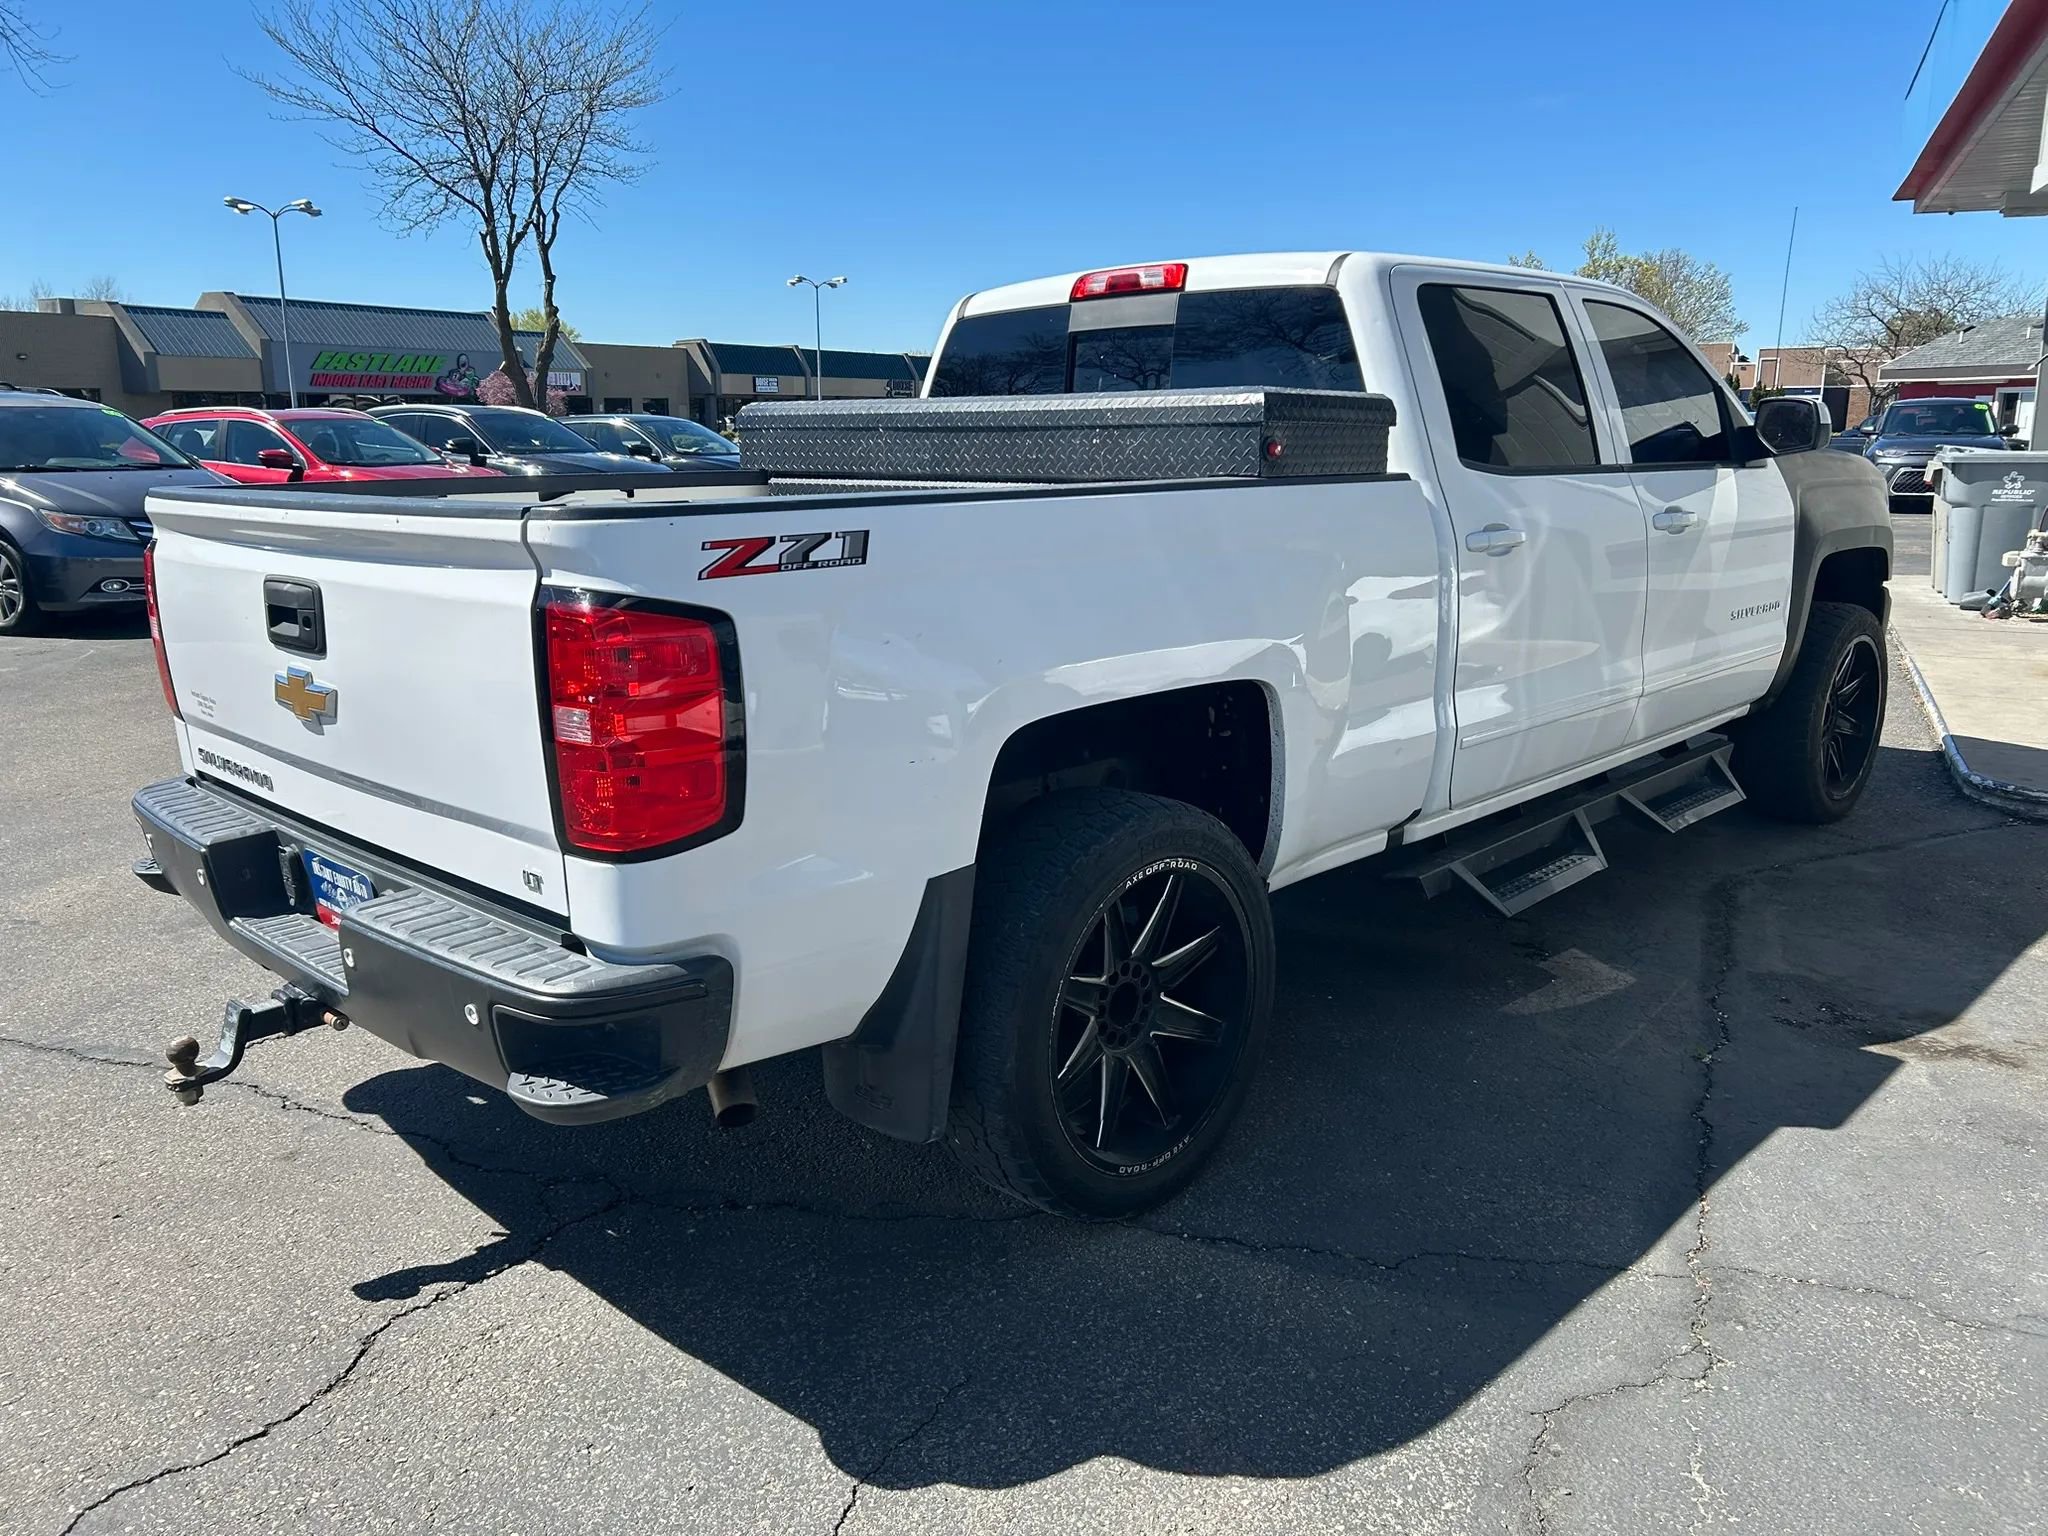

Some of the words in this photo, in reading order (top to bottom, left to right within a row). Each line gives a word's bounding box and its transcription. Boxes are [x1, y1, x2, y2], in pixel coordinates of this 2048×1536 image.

[311, 351, 447, 373] FASTLANE
[310, 373, 358, 387] INDOOR
[359, 374, 387, 388] KART
[390, 375, 434, 389] RACING
[698, 530, 870, 580] Z71
[781, 561, 813, 571] OFF
[817, 557, 863, 568] ROAD
[1730, 600, 1780, 621] SILVERADO
[197, 747, 275, 793] SILVERADO
[522, 869, 544, 895] LT
[1125, 871, 1144, 889] AXE
[1145, 861, 1198, 876] OFF-ROAD
[1173, 1135, 1190, 1154] AXE
[1119, 1151, 1171, 1174] OFF-ROAD
